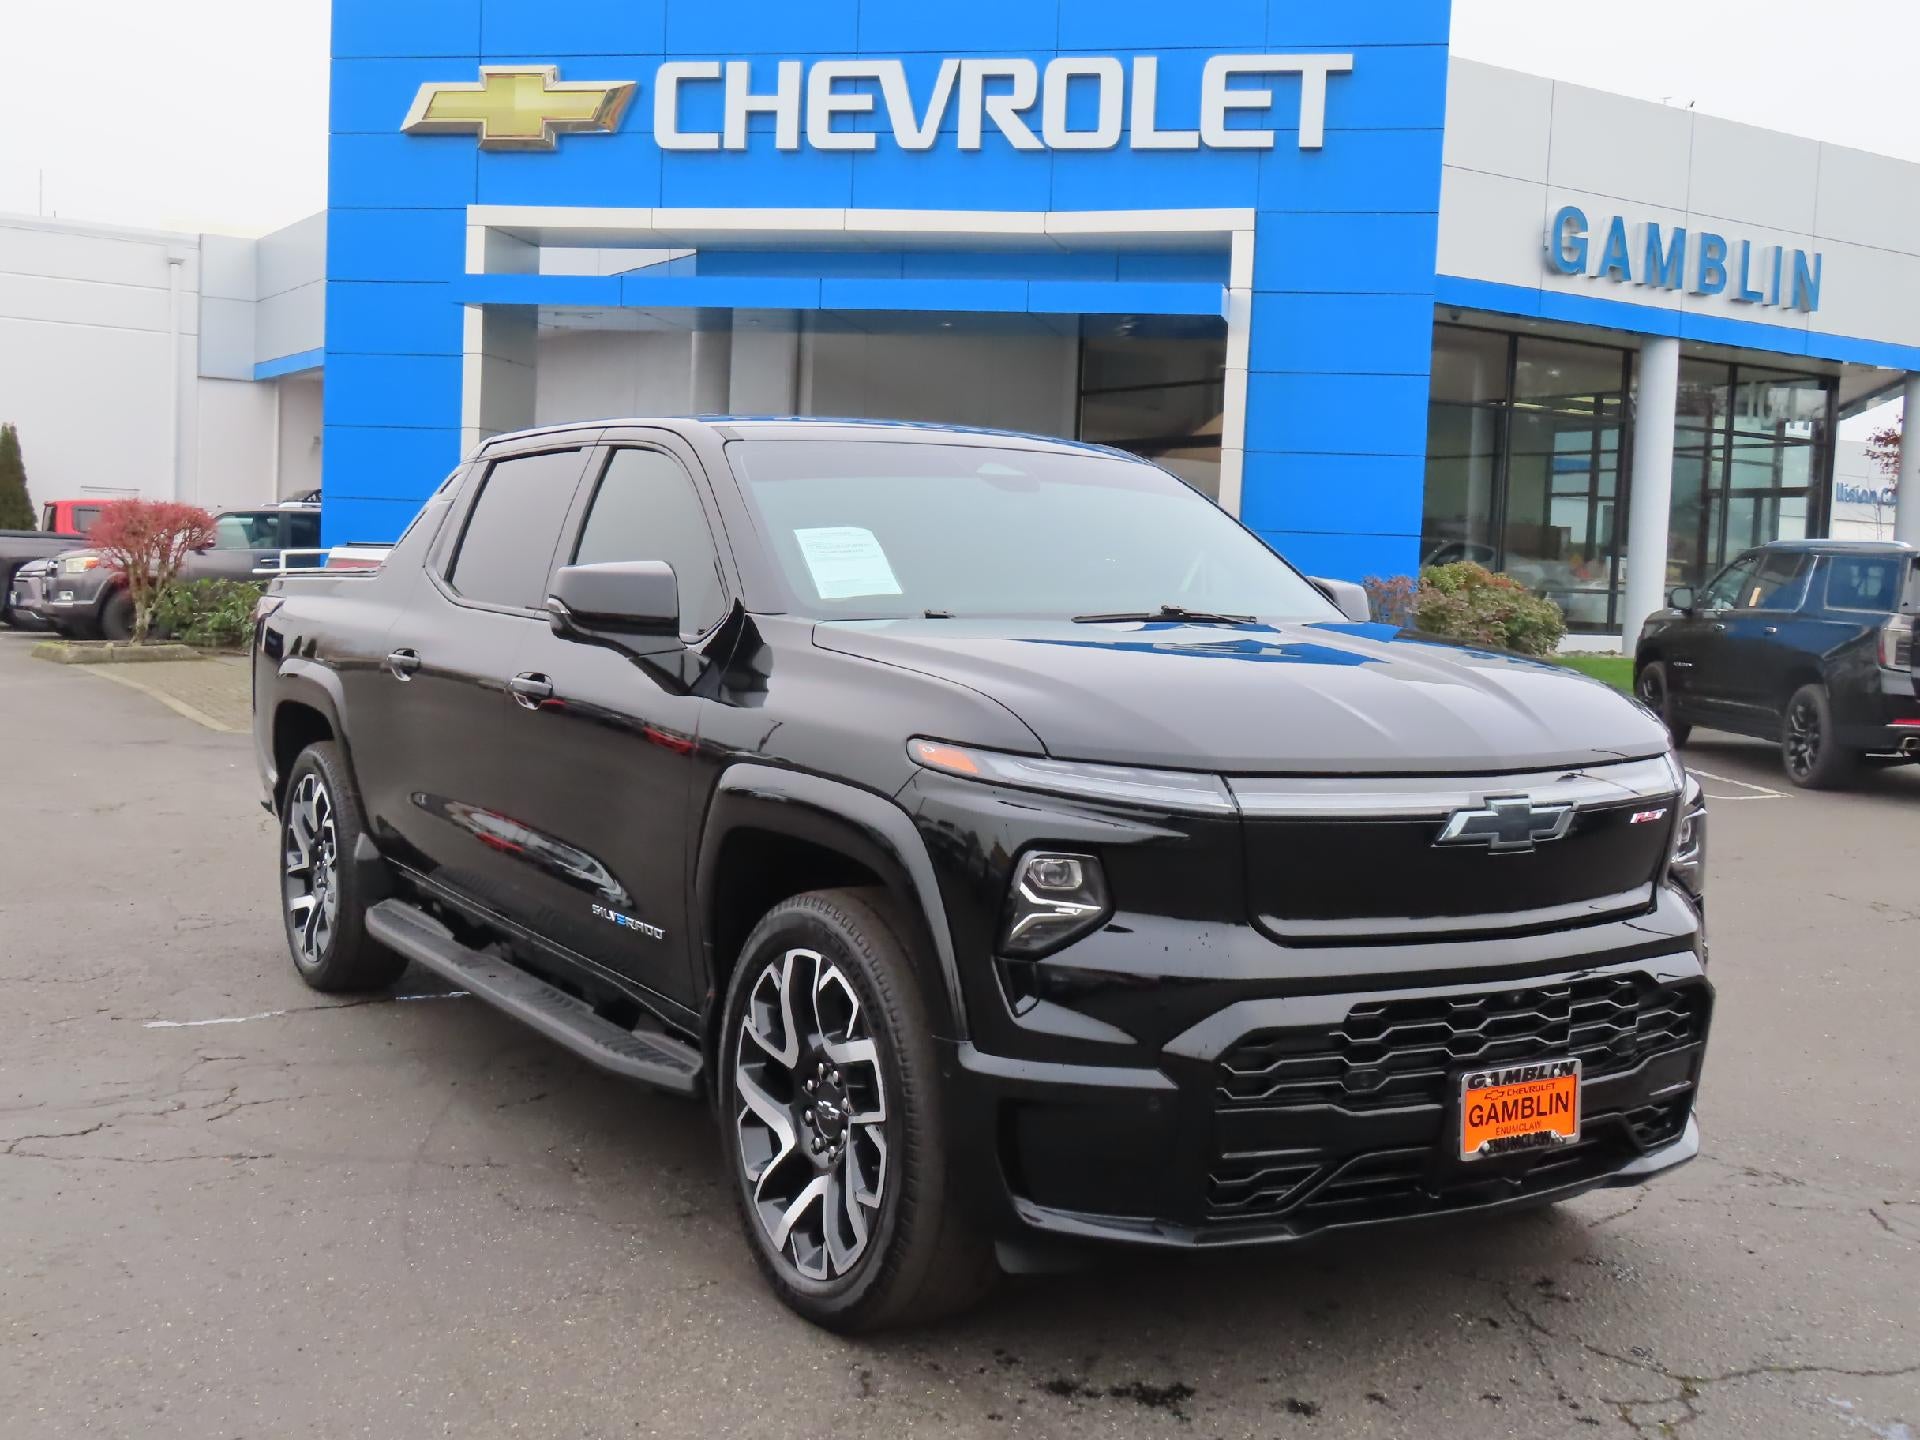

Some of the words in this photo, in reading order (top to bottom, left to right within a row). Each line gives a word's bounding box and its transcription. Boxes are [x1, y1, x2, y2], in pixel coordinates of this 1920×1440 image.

[653, 53, 1354, 152] CHEVROLET
[1545, 205, 1822, 312] GAMBLIN
[592, 904, 665, 940] SILVERADO
[1468, 1061, 1575, 1089] GAMBLIN
[1507, 1083, 1556, 1097] CHEVROLET
[1469, 1091, 1569, 1127] GAMBLIN
[1495, 1121, 1542, 1136] ENUMCLAW
